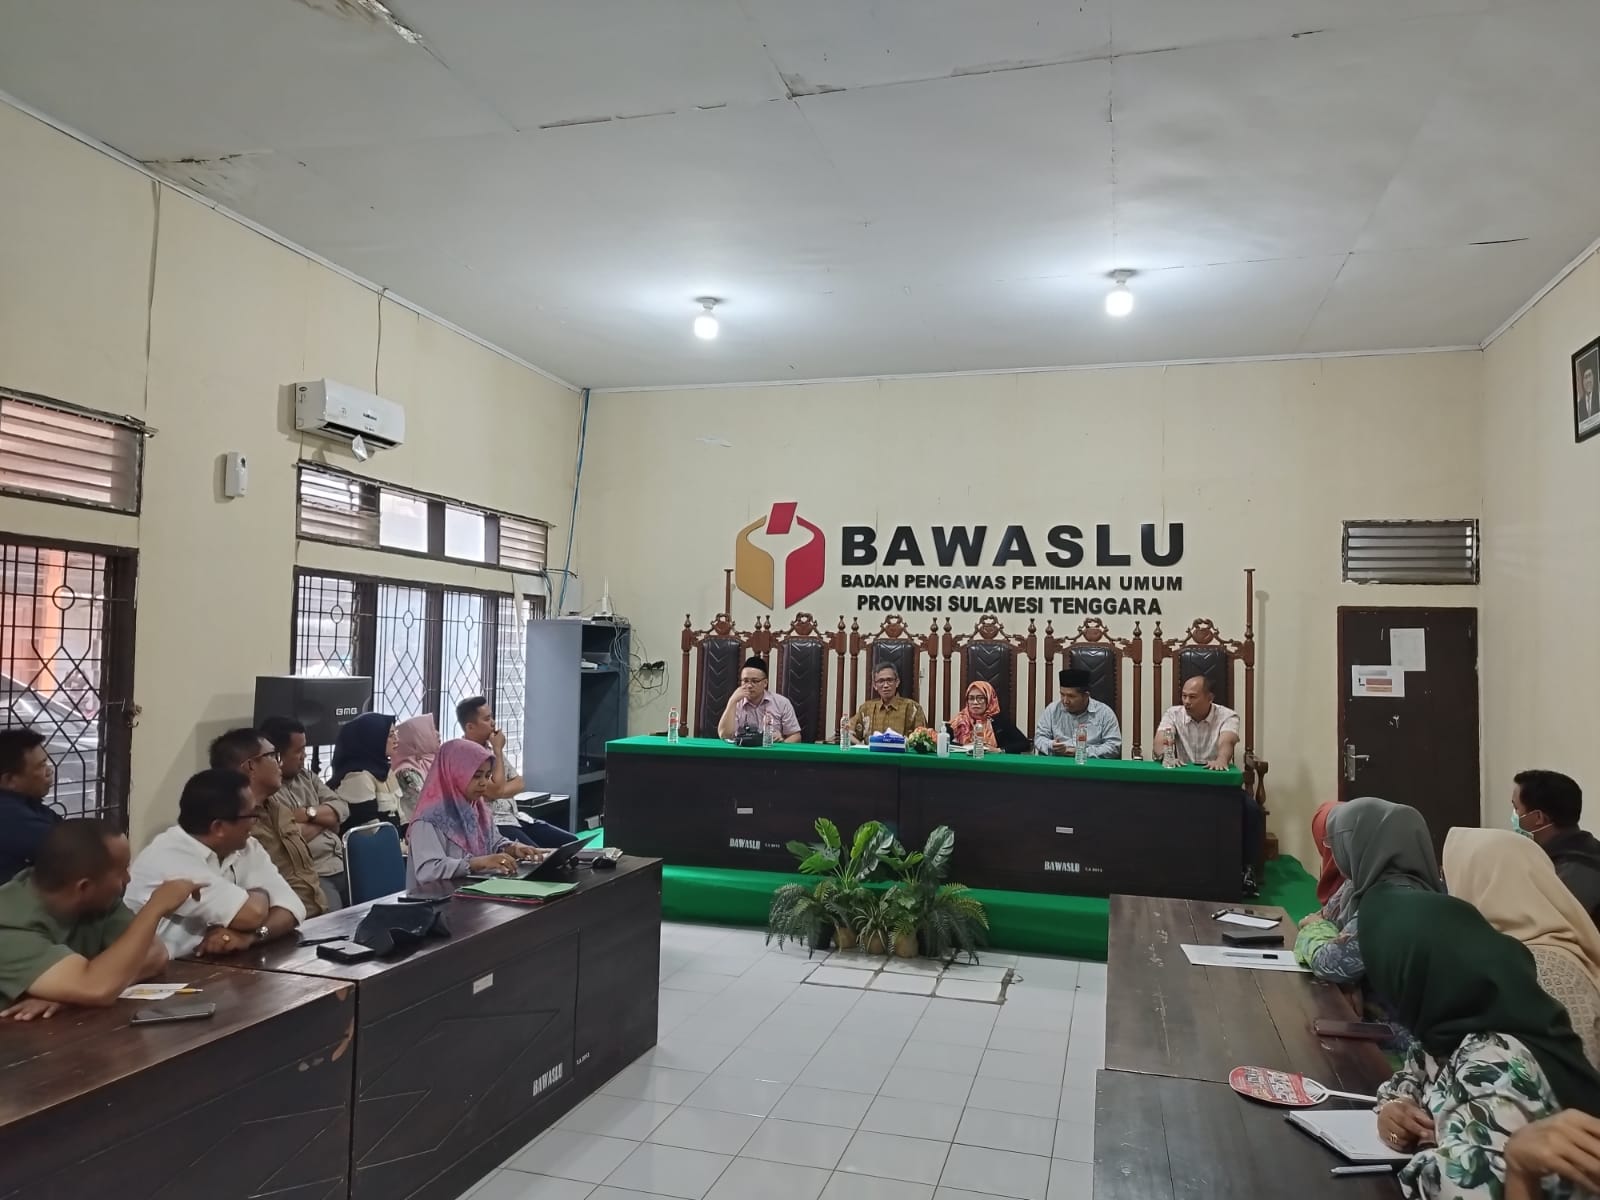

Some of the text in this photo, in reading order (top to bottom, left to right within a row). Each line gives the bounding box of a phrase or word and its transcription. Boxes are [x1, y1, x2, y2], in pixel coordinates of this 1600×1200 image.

[841, 523, 1184, 568] BAWASLU
[841, 574, 1183, 591] BADAN PENGAWAS PEMILIHAN UMUM
[857, 594, 1162, 615] PROVINSI SULAWESI TENGGARA
[729, 838, 761, 850] BAWASLU
[1044, 860, 1081, 873] BAWASLU
[532, 1062, 564, 1097] BAWASLU
